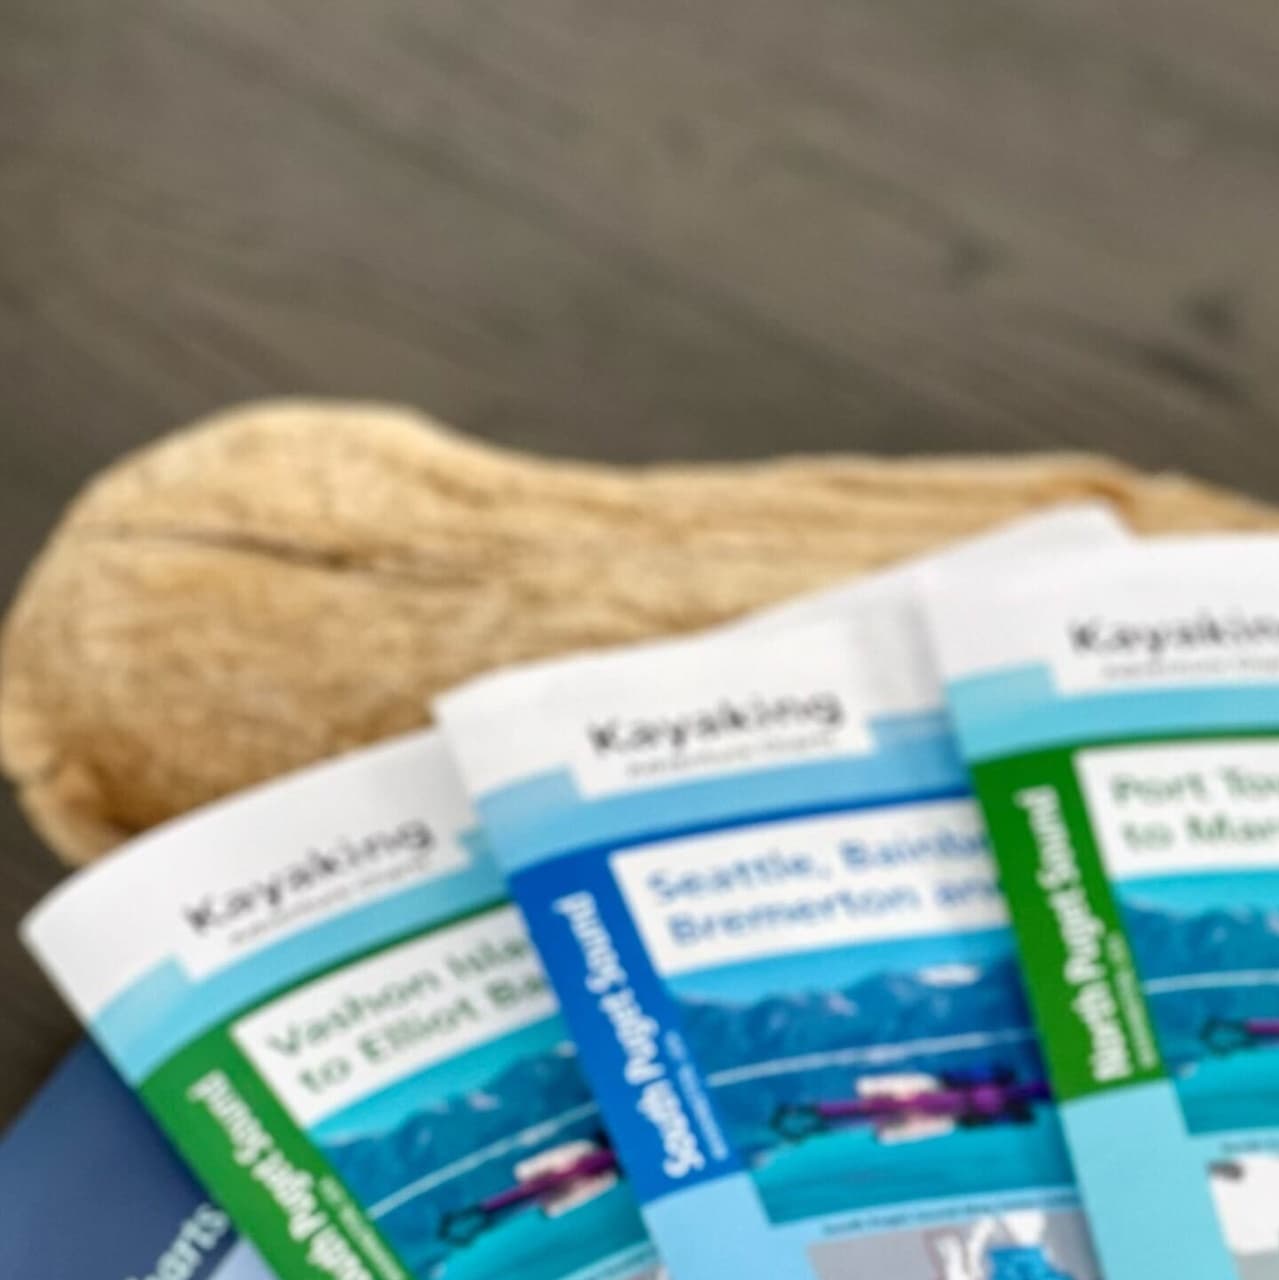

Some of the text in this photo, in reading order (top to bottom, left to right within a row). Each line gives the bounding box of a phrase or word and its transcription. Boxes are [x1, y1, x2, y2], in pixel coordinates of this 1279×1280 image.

[586, 692, 846, 755] Kayaking
[1111, 768, 1206, 803] Port
[178, 819, 438, 936] Kayaking
[645, 848, 832, 902] Seattle,
[1012, 783, 1083, 892] Sound
[1121, 818, 1174, 851] to
[551, 888, 629, 996] Sound
[667, 881, 922, 949] Bremerton
[1047, 886, 1108, 986] Puget
[263, 969, 442, 1057] Vashon
[599, 986, 666, 1086] Puget
[1071, 978, 1135, 1082] North
[185, 1066, 273, 1166] Sound
[296, 1053, 352, 1094] to
[636, 1076, 707, 1179] South
[250, 1149, 329, 1243] Puget
